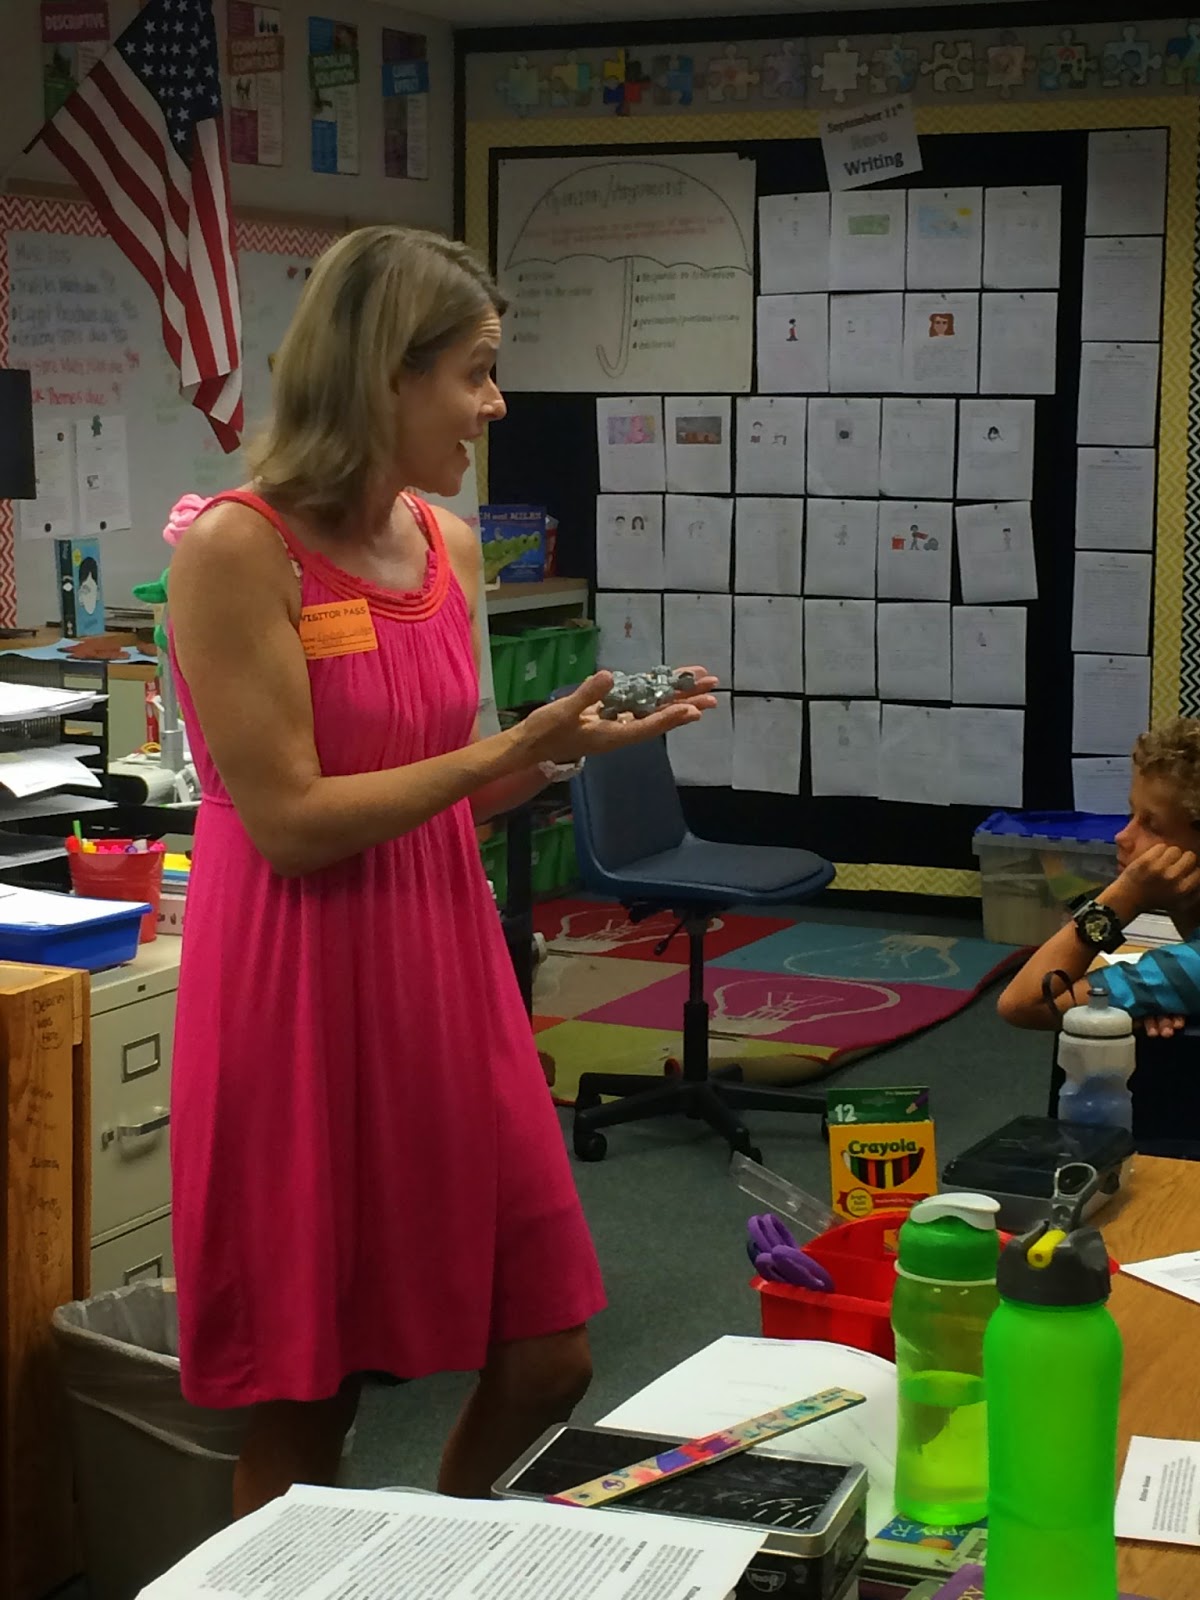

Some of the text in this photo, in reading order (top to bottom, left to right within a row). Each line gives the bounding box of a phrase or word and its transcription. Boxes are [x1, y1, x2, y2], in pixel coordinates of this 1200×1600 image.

[827, 112, 883, 135] September
[843, 152, 905, 176] Writing
[343, 606, 366, 615] PASS
[835, 1104, 857, 1122] 12
[848, 1138, 917, 1156] Crayola
